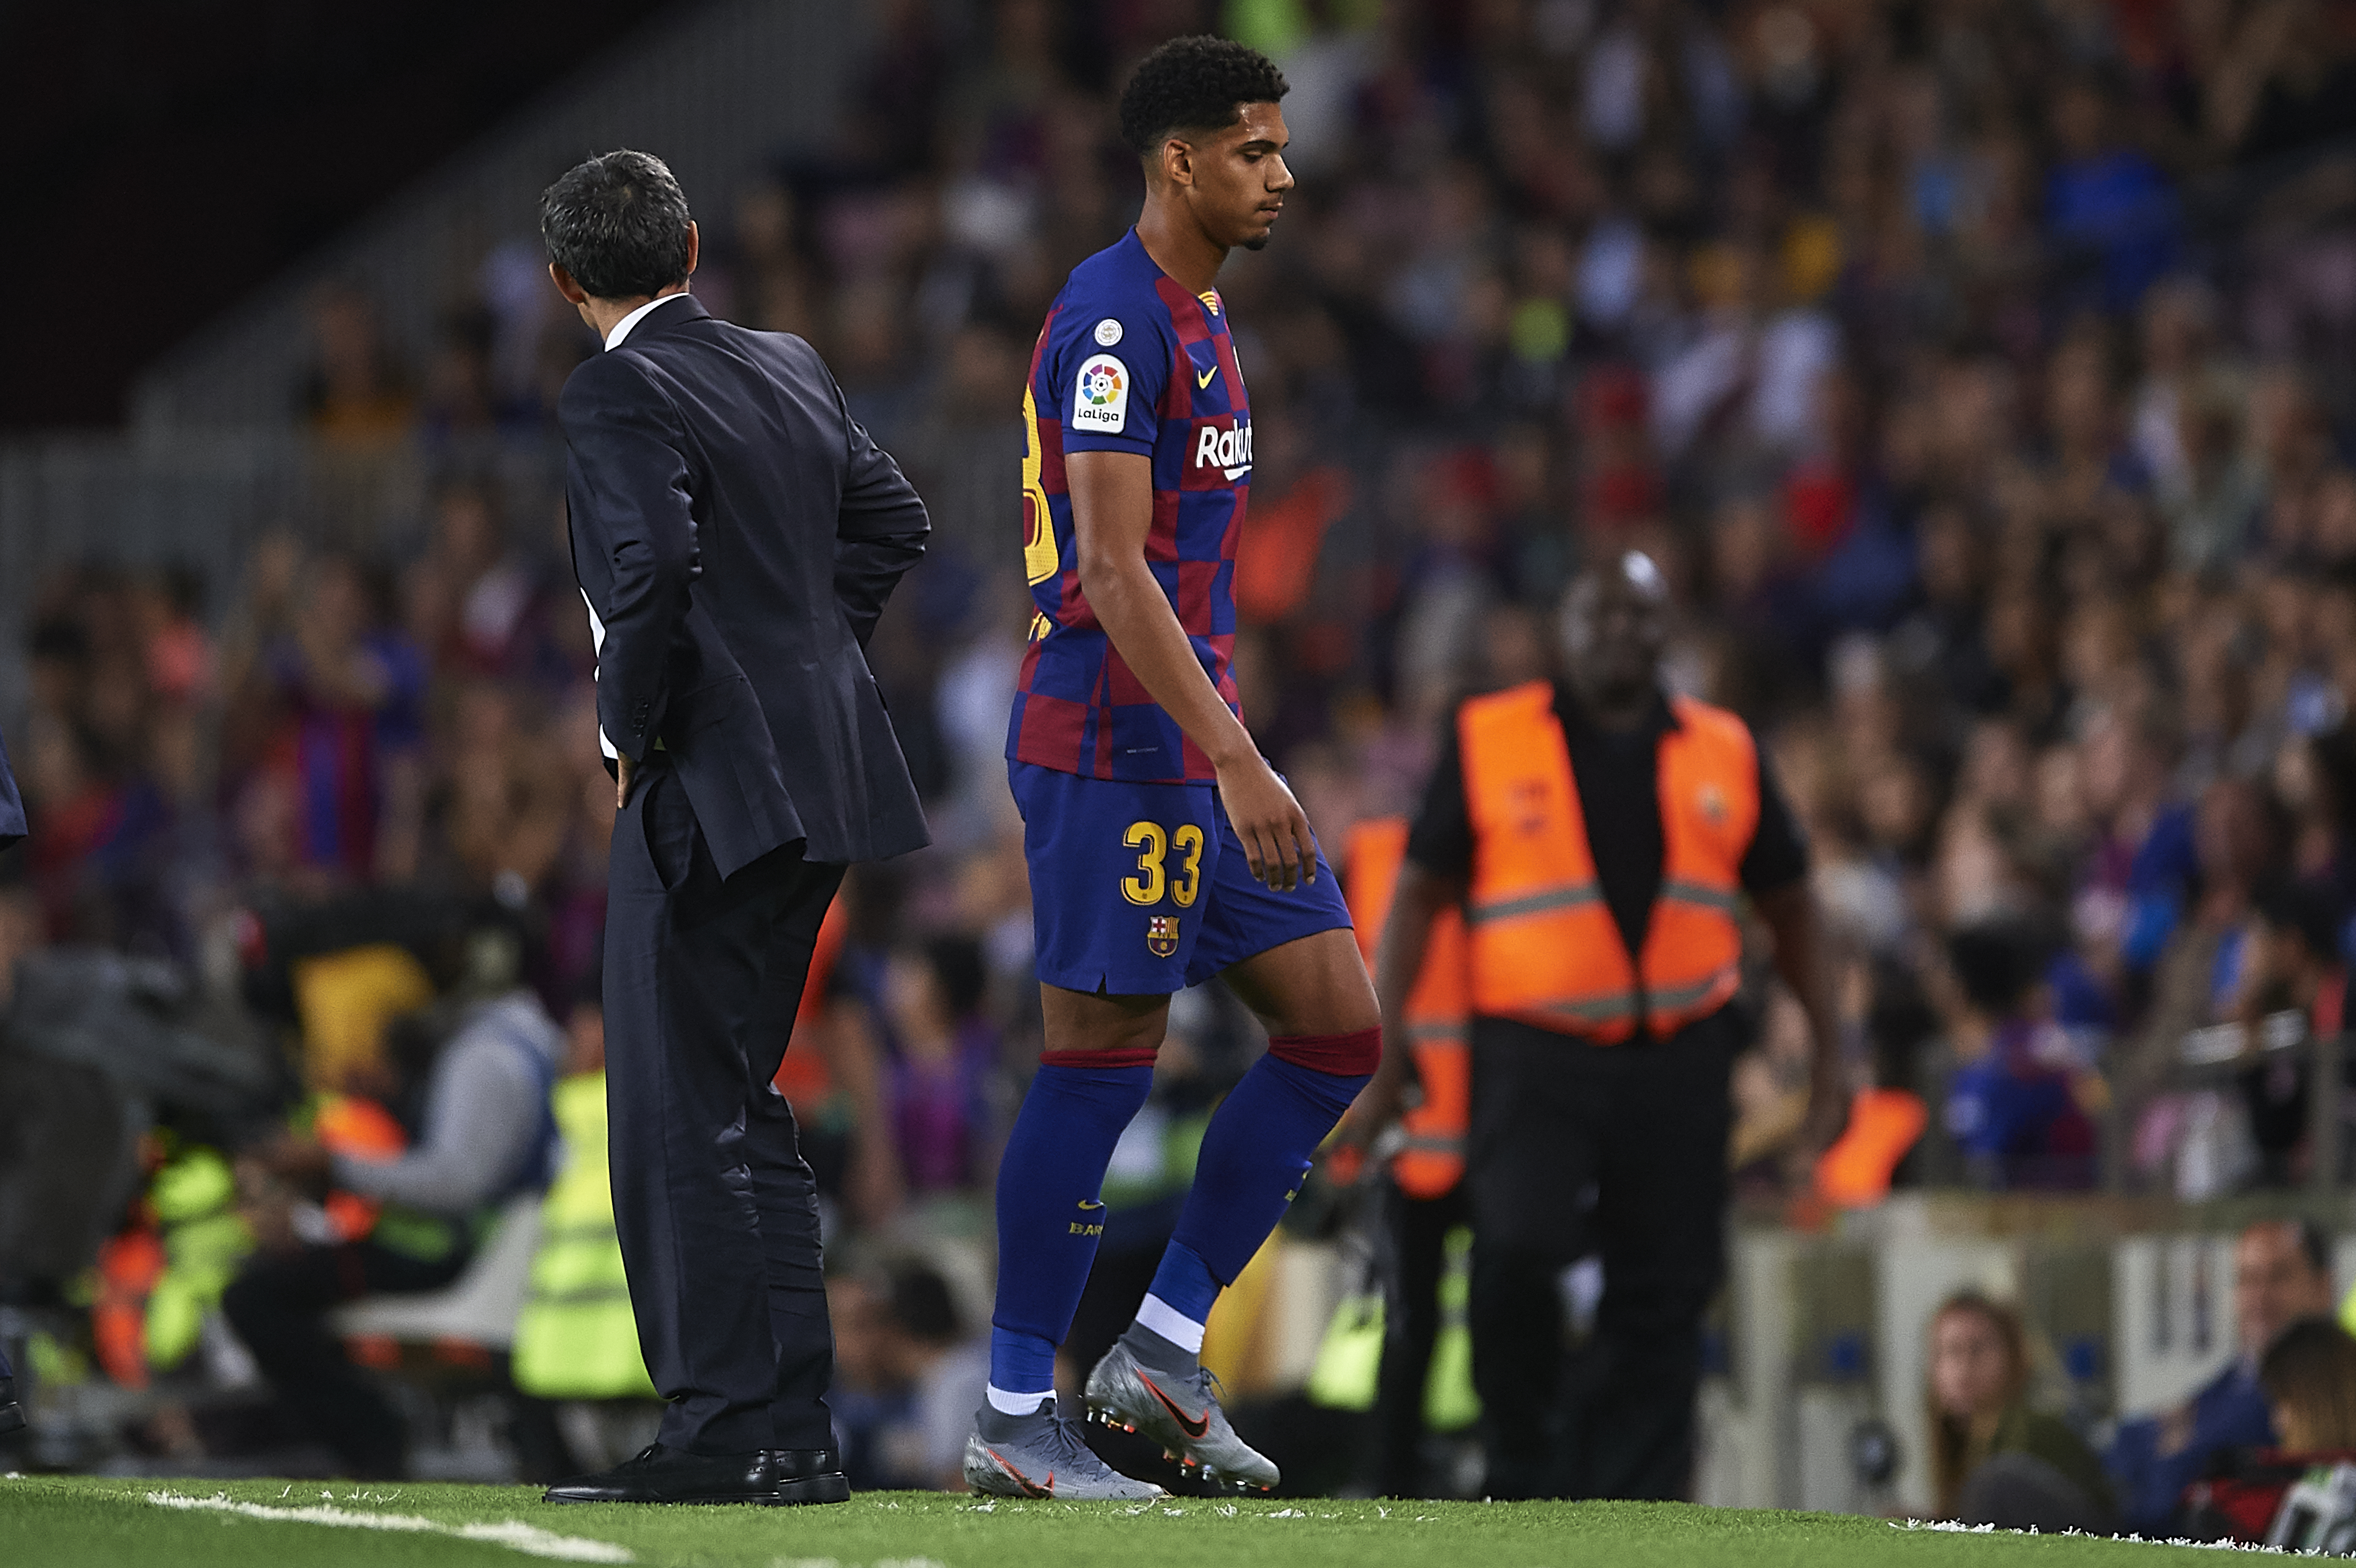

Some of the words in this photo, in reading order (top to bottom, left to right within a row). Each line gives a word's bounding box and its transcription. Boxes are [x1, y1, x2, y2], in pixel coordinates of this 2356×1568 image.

[1078, 408, 1119, 422] LaLiga
[1120, 821, 1204, 908] 33
[1069, 1221, 1103, 1236] BAR
